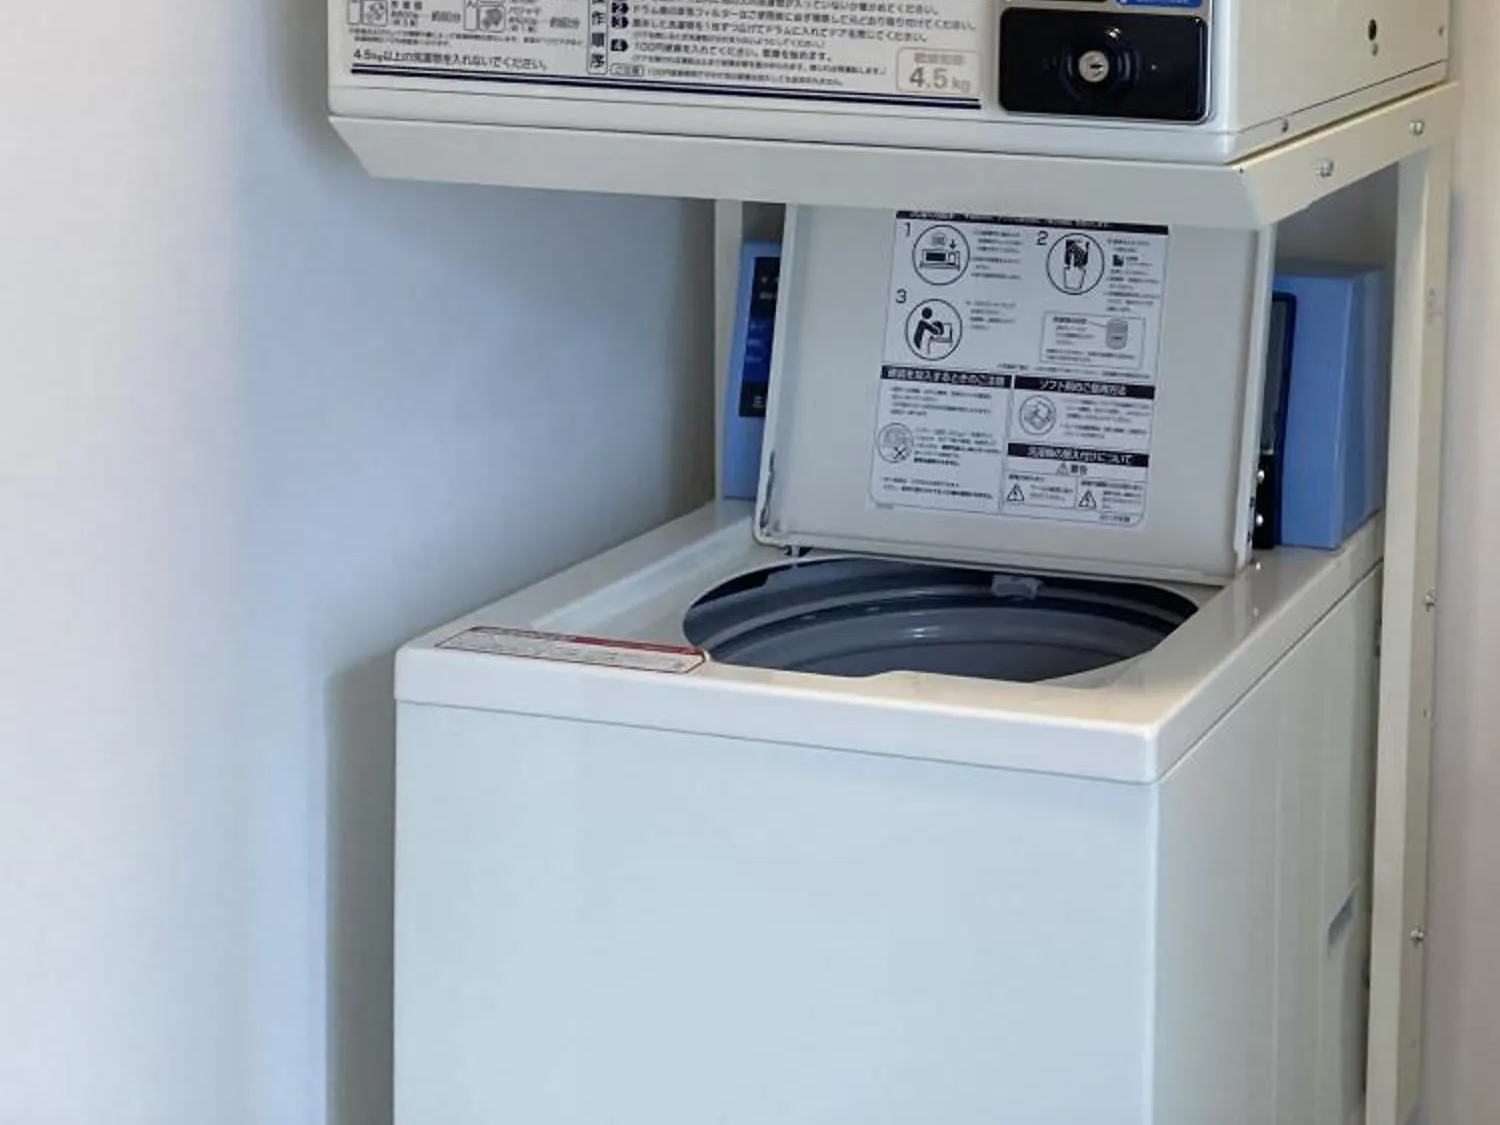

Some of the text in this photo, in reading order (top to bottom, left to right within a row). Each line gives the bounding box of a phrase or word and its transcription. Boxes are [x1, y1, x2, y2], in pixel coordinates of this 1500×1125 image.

[909, 66, 947, 89] 4.5
[904, 222, 911, 236] 1
[1036, 230, 1049, 246] 2
[896, 288, 907, 304] 3
